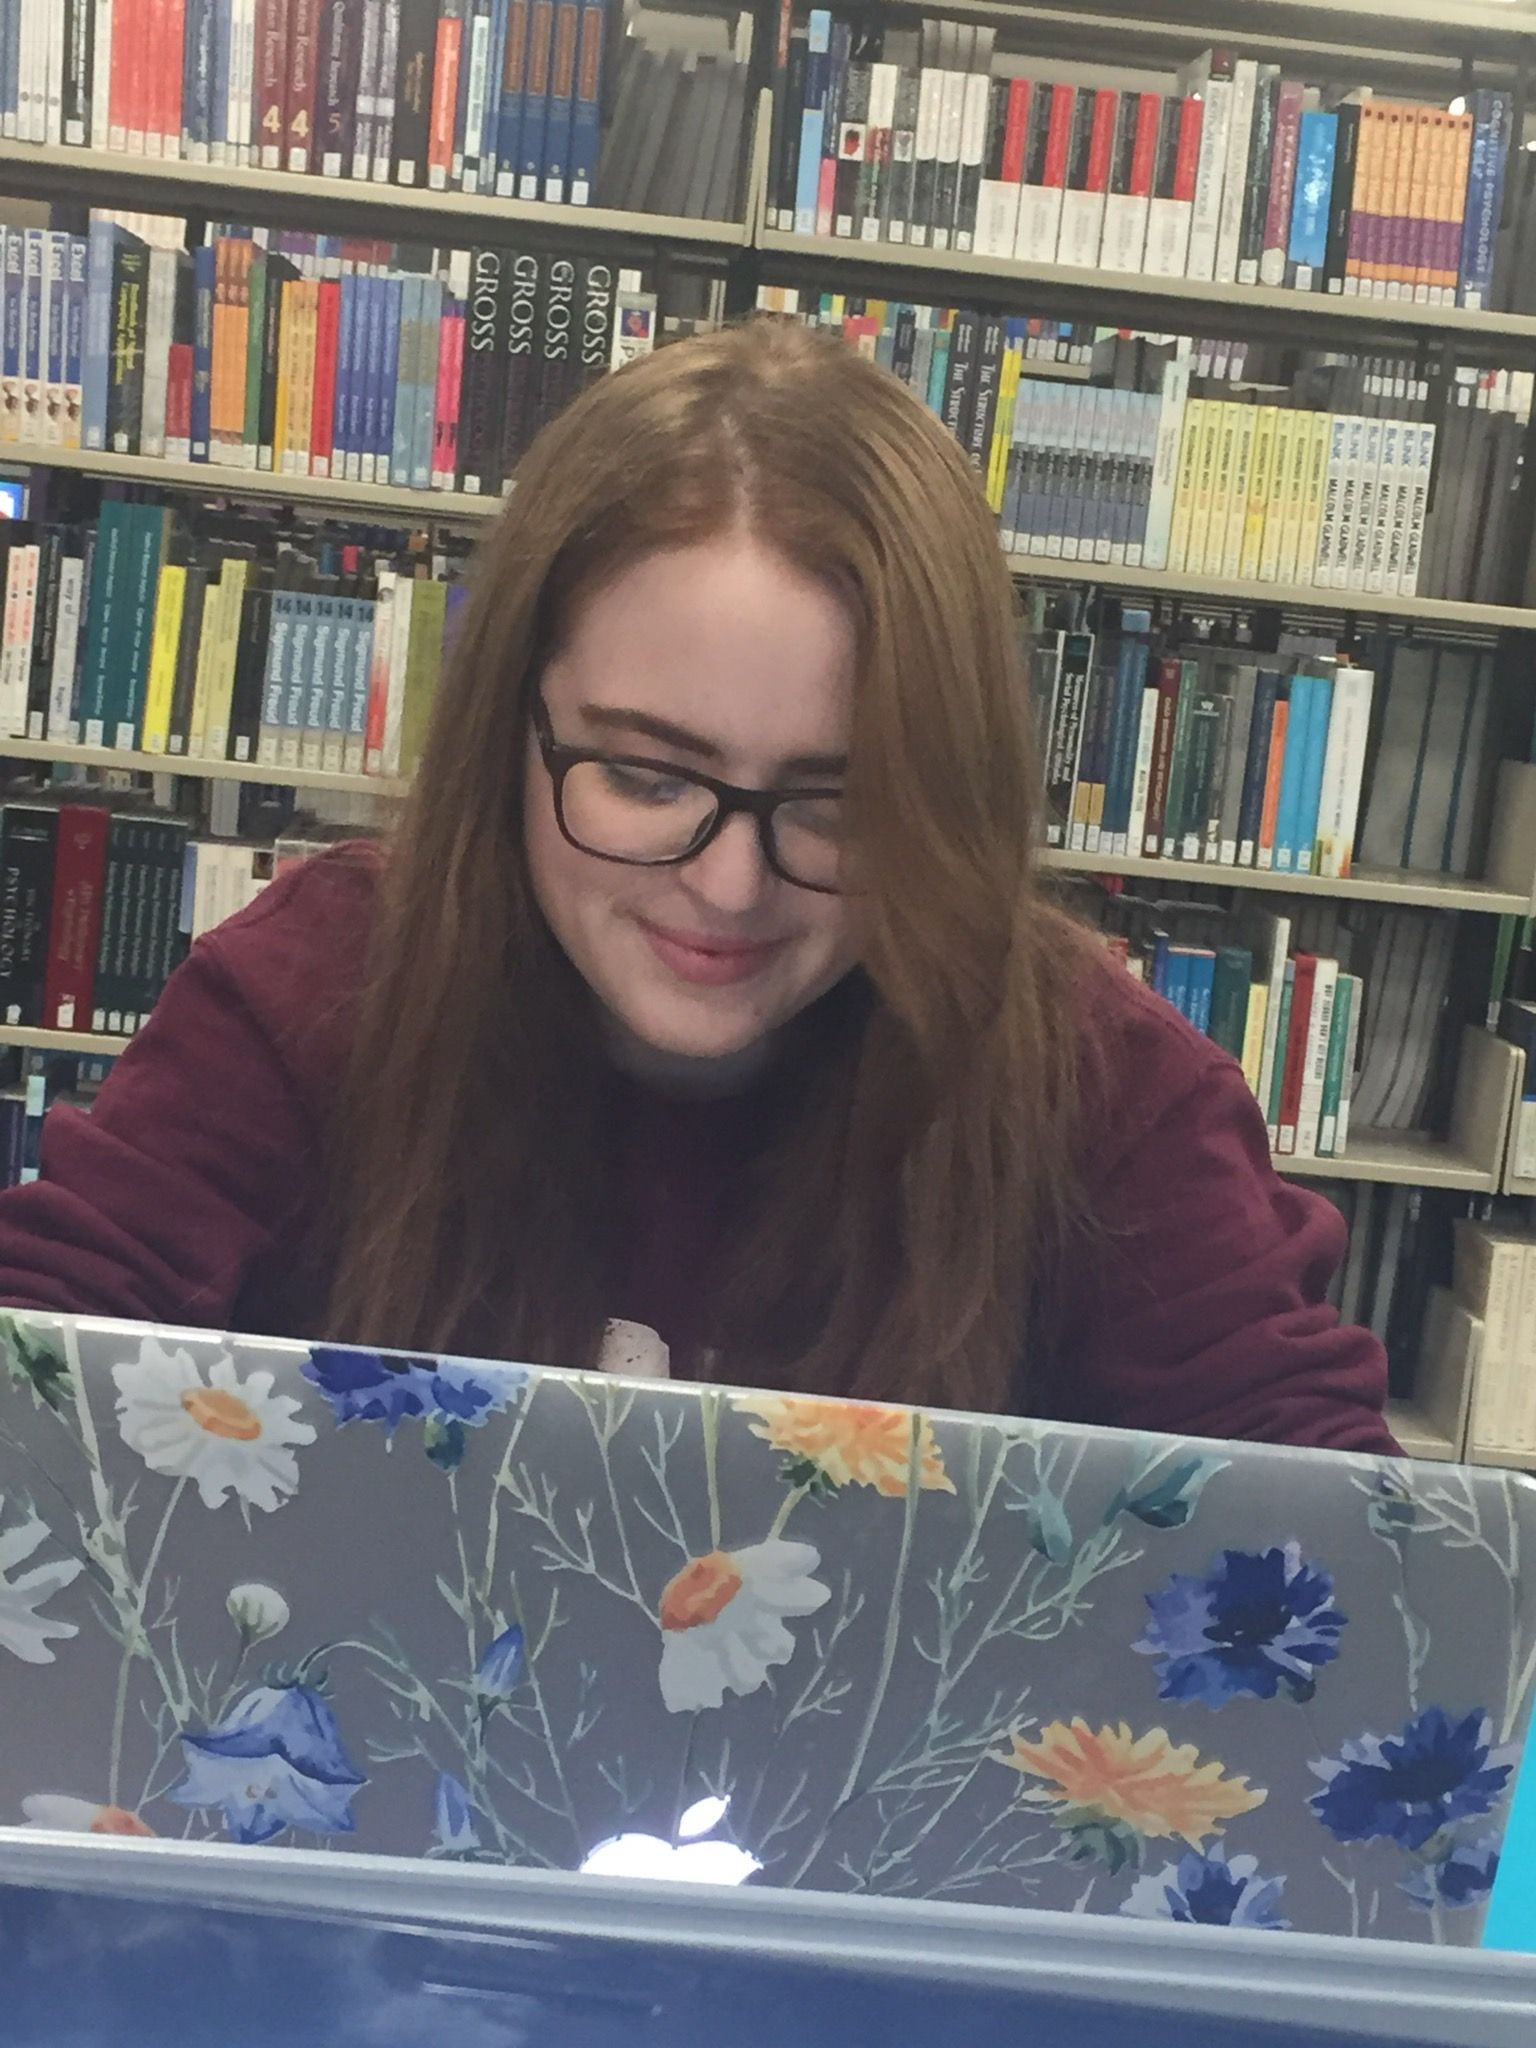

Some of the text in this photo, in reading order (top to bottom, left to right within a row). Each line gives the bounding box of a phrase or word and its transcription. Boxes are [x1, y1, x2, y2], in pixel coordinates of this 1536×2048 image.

[264, 31, 280, 87] Research
[291, 36, 310, 92] Research
[262, 105, 281, 133] 4
[291, 109, 309, 138] 4
[1486, 100, 1503, 176] COGNITIVE
[8, 236, 22, 274] Excel
[1476, 182, 1494, 273] PSYCHOLOGY
[29, 239, 41, 276] Excel
[51, 243, 64, 280] Excel
[70, 244, 86, 282] Excel
[471, 252, 500, 352] GROSS
[508, 255, 539, 354] GROSS
[544, 261, 575, 360] GROSS
[581, 265, 612, 364] GROSS
[953, 362, 968, 381] THE
[980, 364, 996, 383] THE
[973, 389, 993, 448] STRUCTURE
[1318, 422, 1345, 568] BLINK MALCOLM GLADWELL
[1336, 424, 1362, 568] BLINK MALCOLM GLADWELL
[1353, 426, 1379, 570] BLINK MALCOLM GLADWELL
[1370, 428, 1397, 572] BLINK MALCOLM GLADWELL
[1387, 430, 1414, 574] BLINK MALCOLM GLADWELL
[1404, 431, 1430, 575] BLINK MALCOLM GLADWELL
[64, 578, 74, 600] way
[65, 604, 75, 615] of
[275, 598, 292, 615] 14
[295, 600, 311, 616] 14
[316, 602, 332, 617] 14
[338, 603, 353, 619] 14
[358, 606, 374, 623] 14
[266, 622, 288, 724] Sigmund Freud
[286, 624, 308, 725] Sigmund Freud
[308, 626, 330, 726] Sigmund Freud
[328, 628, 350, 729] Sigmund Freud
[350, 630, 371, 732] Sigmund Freud
[1057, 698, 1072, 749] Psychological
[1064, 722, 1079, 764] Personality
[1062, 766, 1071, 782] and
[0, 867, 20, 978] PSYCHOLOGY
